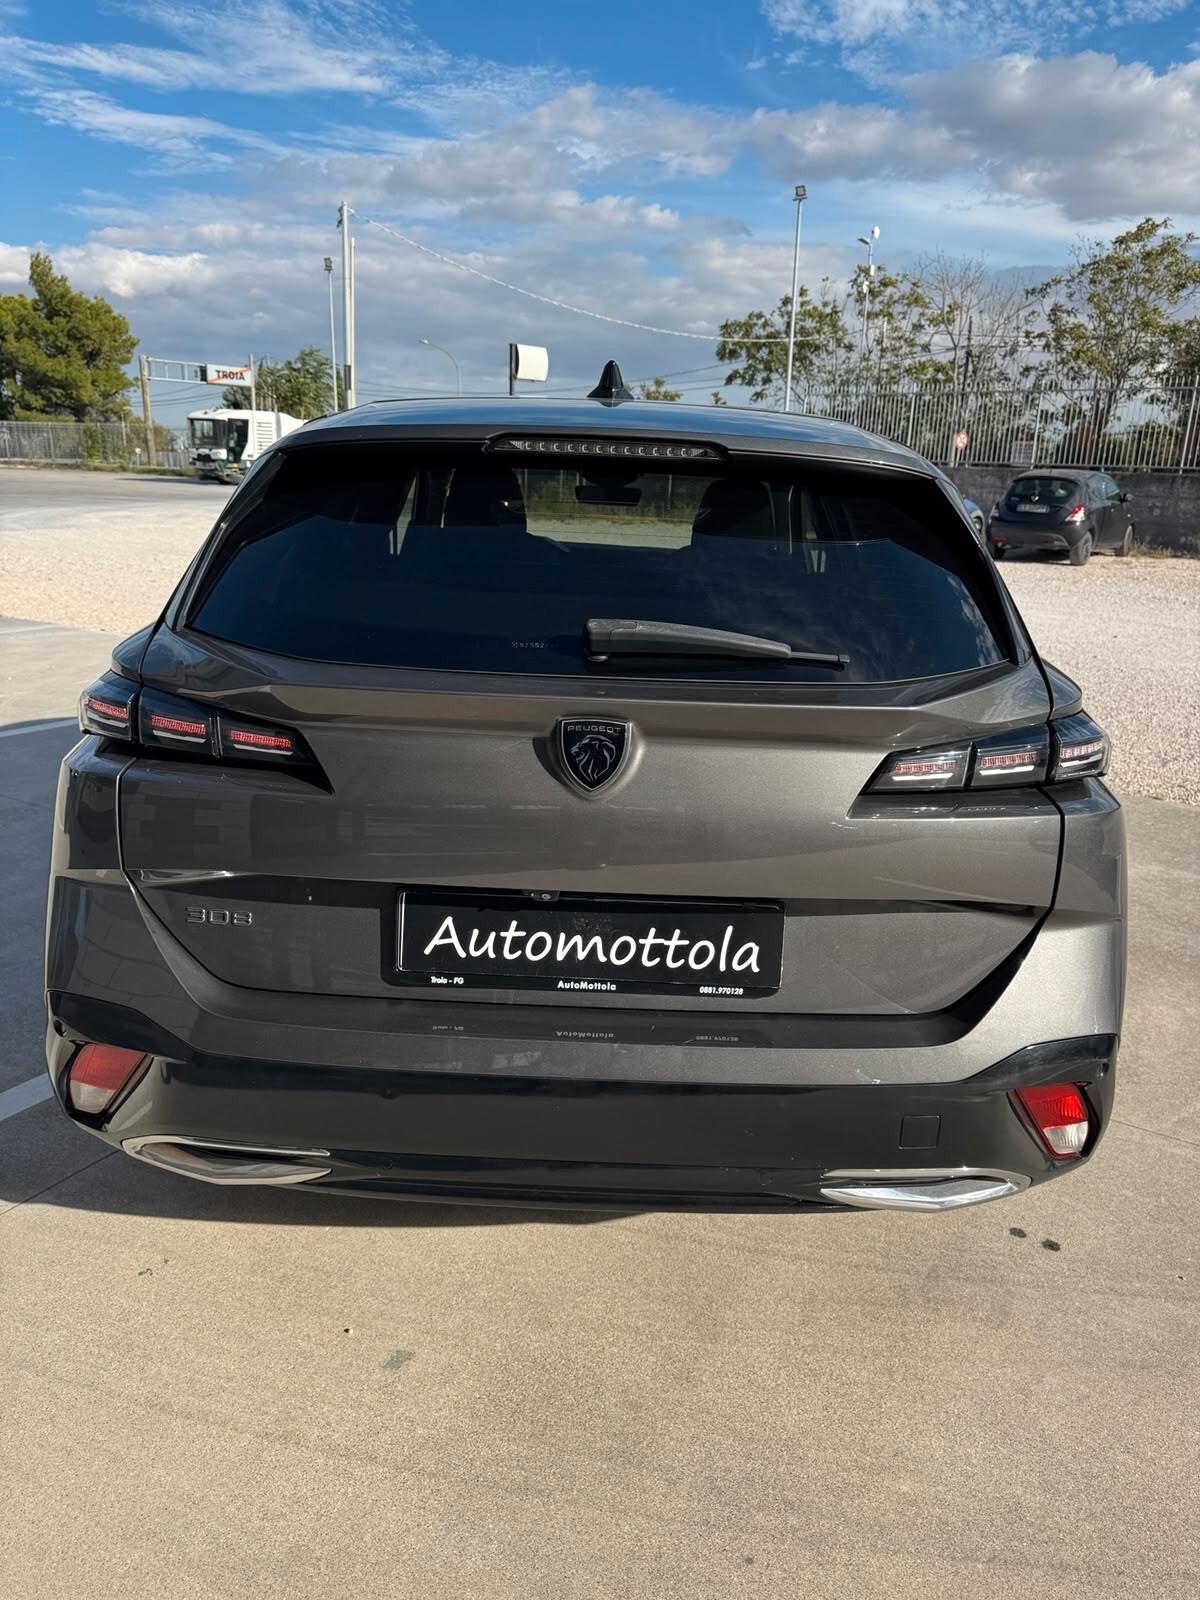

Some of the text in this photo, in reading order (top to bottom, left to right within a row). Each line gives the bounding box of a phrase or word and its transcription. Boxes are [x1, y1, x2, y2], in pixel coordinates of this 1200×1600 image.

[215, 369, 245, 381] TROIA
[567, 724, 622, 733] PEUGEOT
[184, 906, 252, 926] 308
[423, 915, 760, 973] Automottola
[453, 976, 464, 985] FG
[557, 980, 617, 991] AutoMottola
[699, 986, 744, 995] 0881.970128
